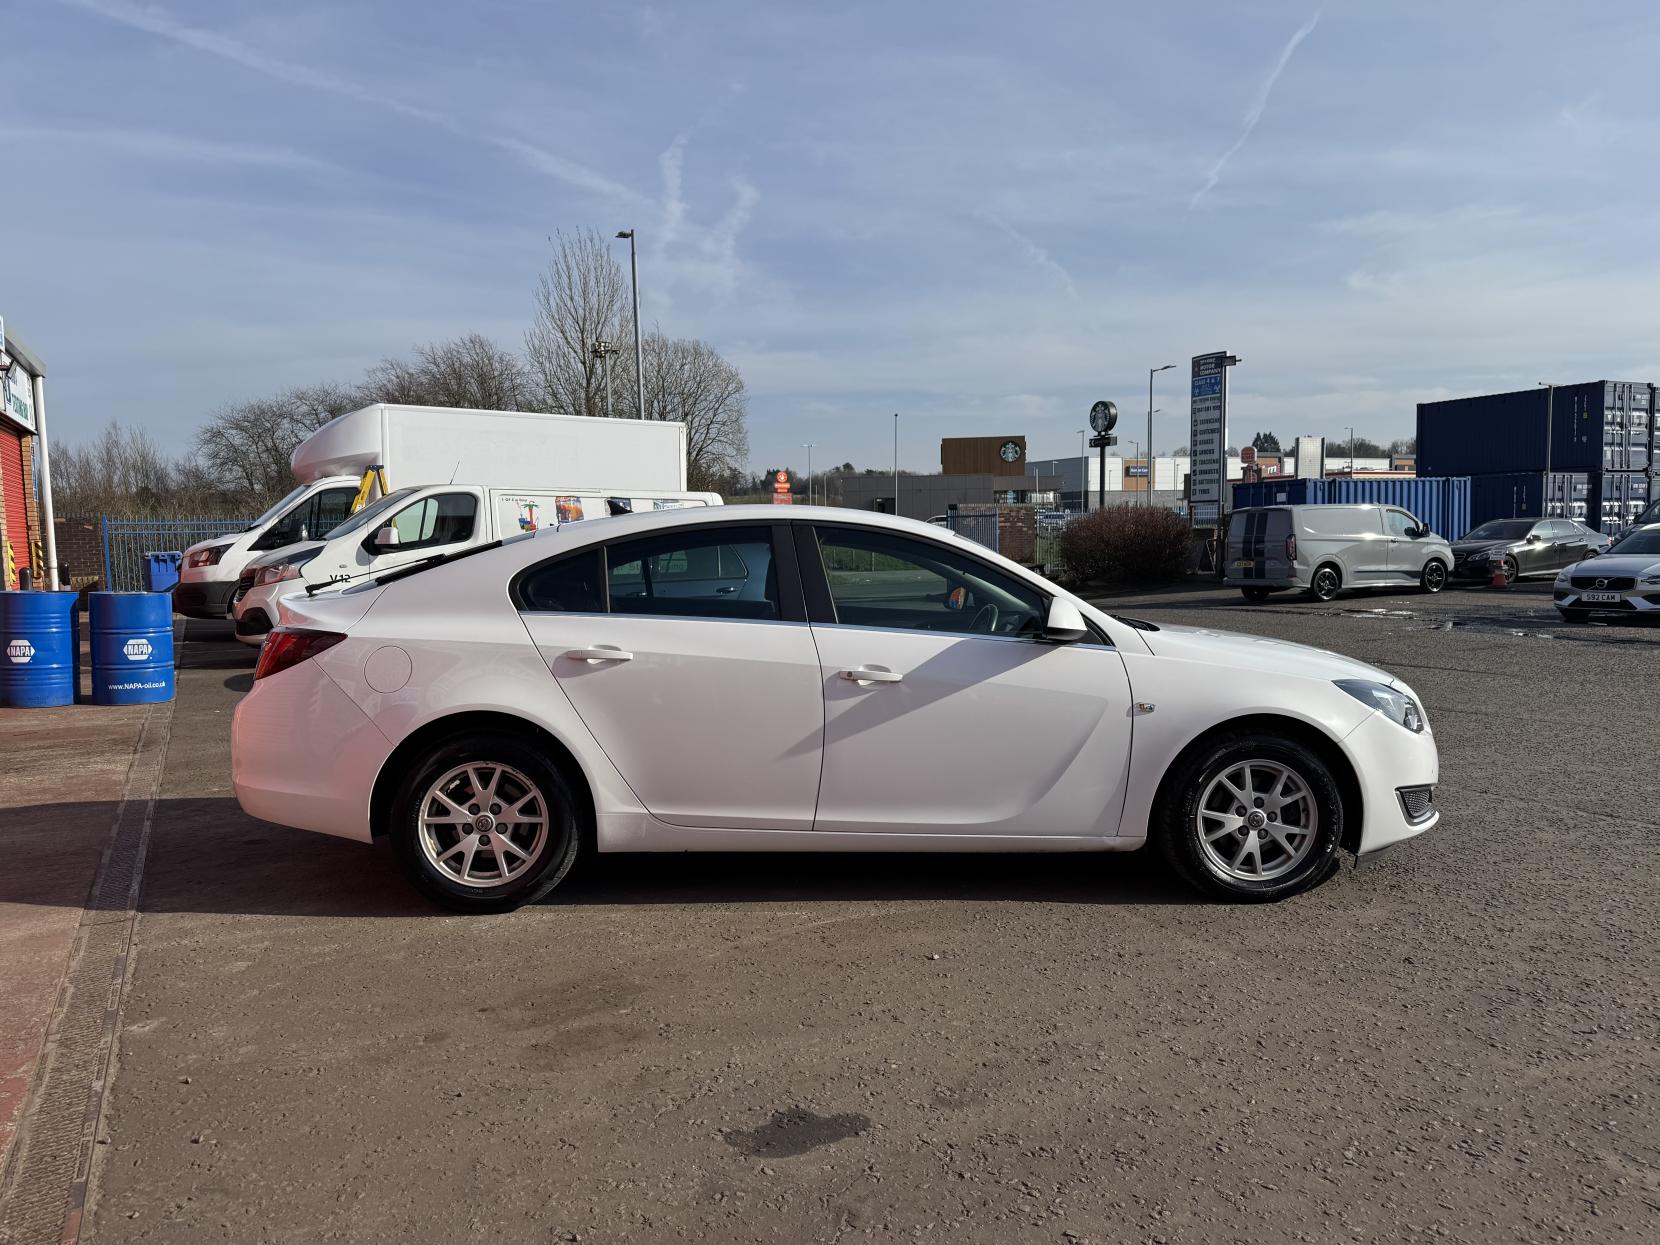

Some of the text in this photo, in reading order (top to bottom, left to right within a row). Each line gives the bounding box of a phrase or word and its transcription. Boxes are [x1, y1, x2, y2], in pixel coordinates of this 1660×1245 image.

[1586, 593, 1600, 601] S92
[10, 646, 31, 657] NAPA
[127, 644, 149, 655] NAPA
[108, 680, 166, 690] www.NAPA-oil.co.uk
